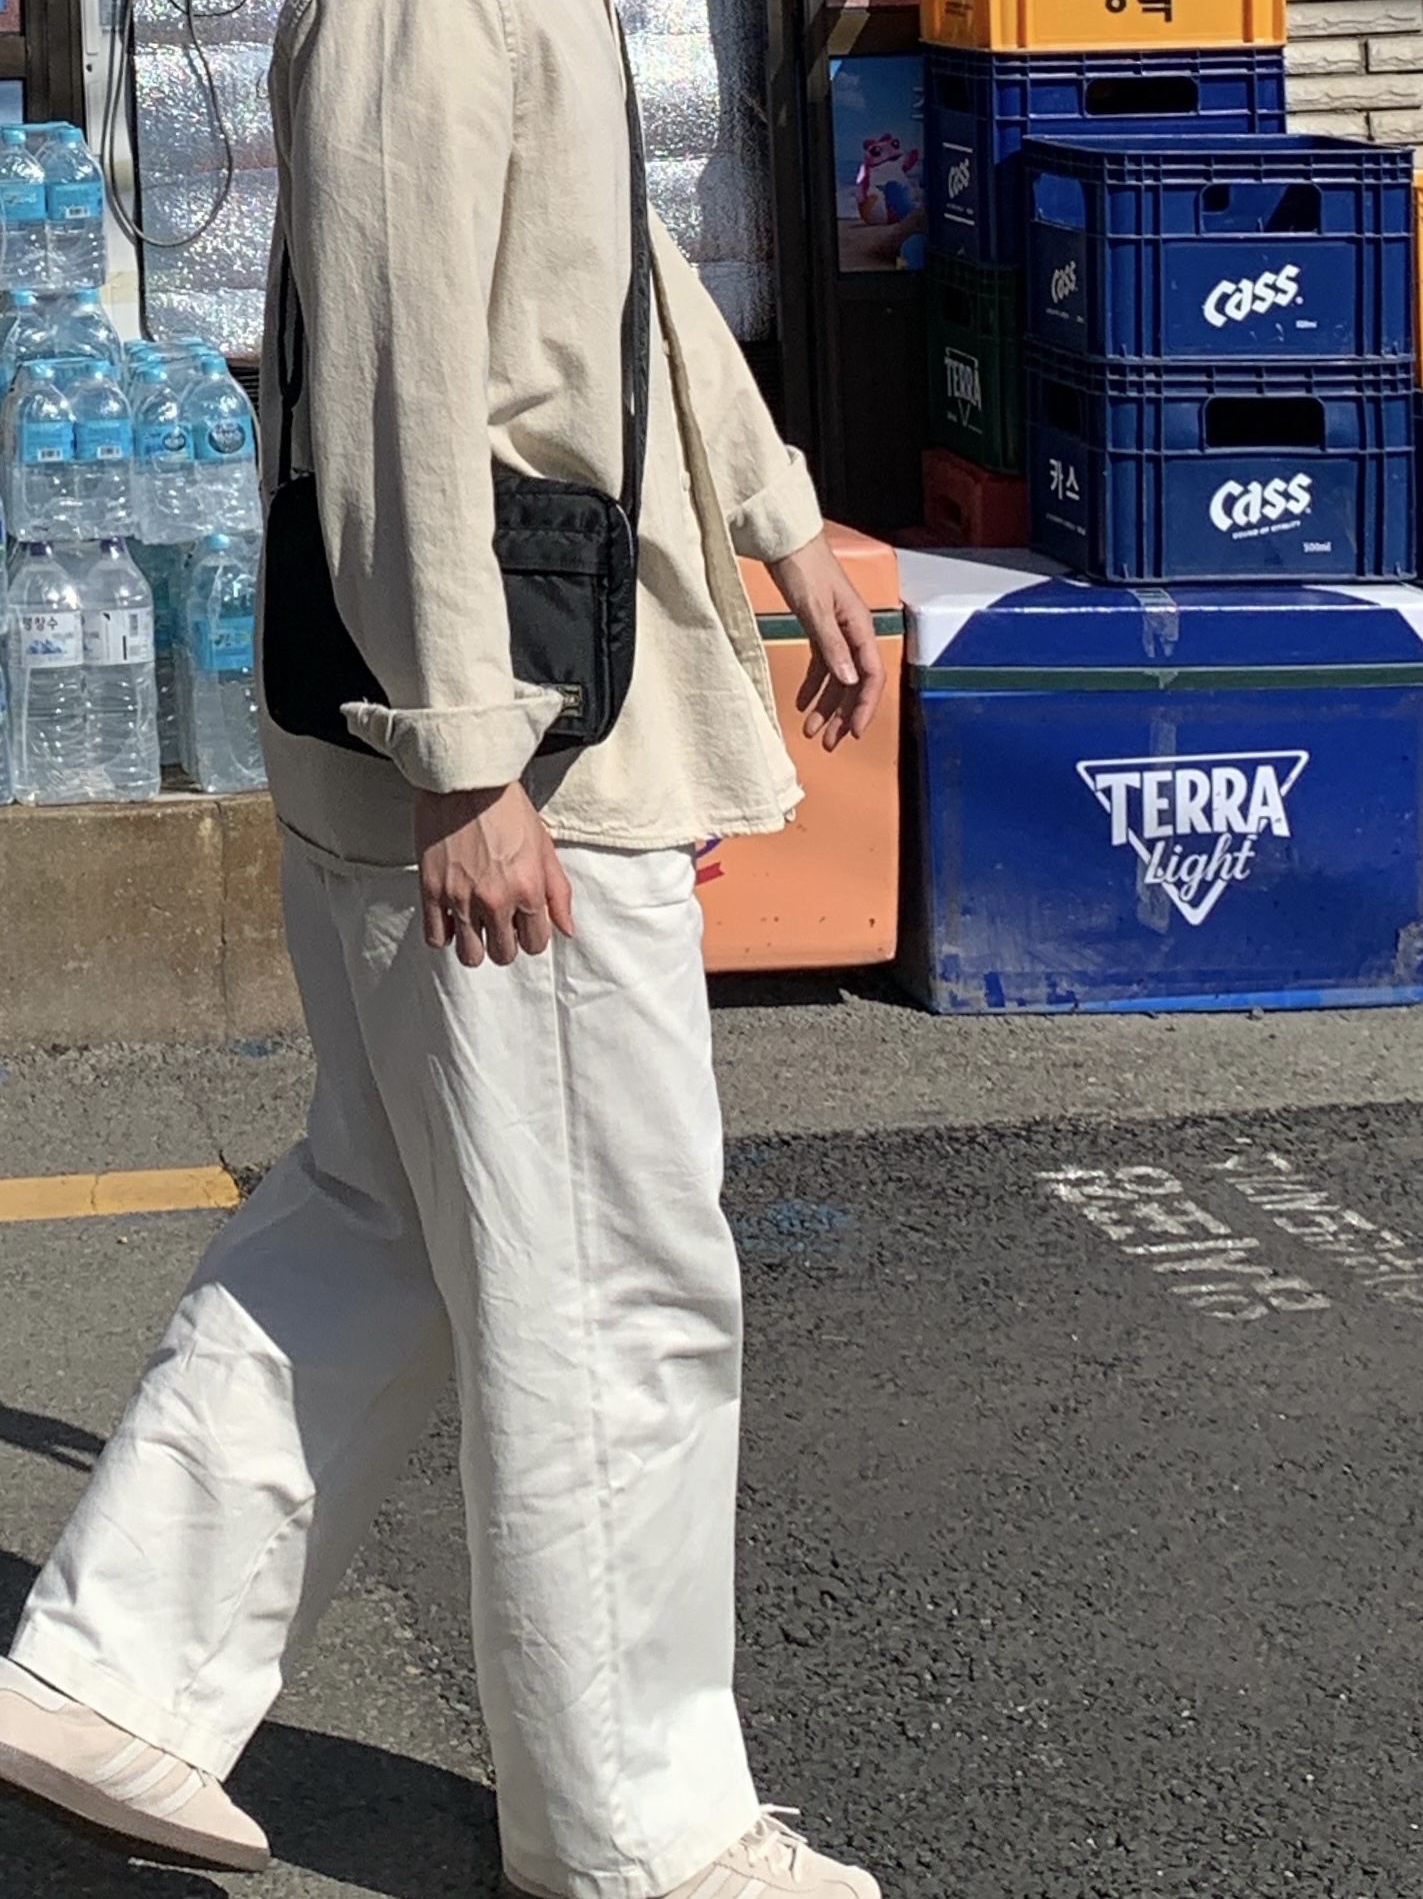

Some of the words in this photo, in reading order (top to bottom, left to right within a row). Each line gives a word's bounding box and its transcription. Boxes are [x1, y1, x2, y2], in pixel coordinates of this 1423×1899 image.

[1203, 263, 1303, 328] Cass
[944, 355, 983, 412] TERRA
[1049, 458, 1079, 500] 카스
[1209, 472, 1314, 532] Cass
[1095, 764, 1291, 847] TERRA
[1143, 833, 1256, 902] Light
